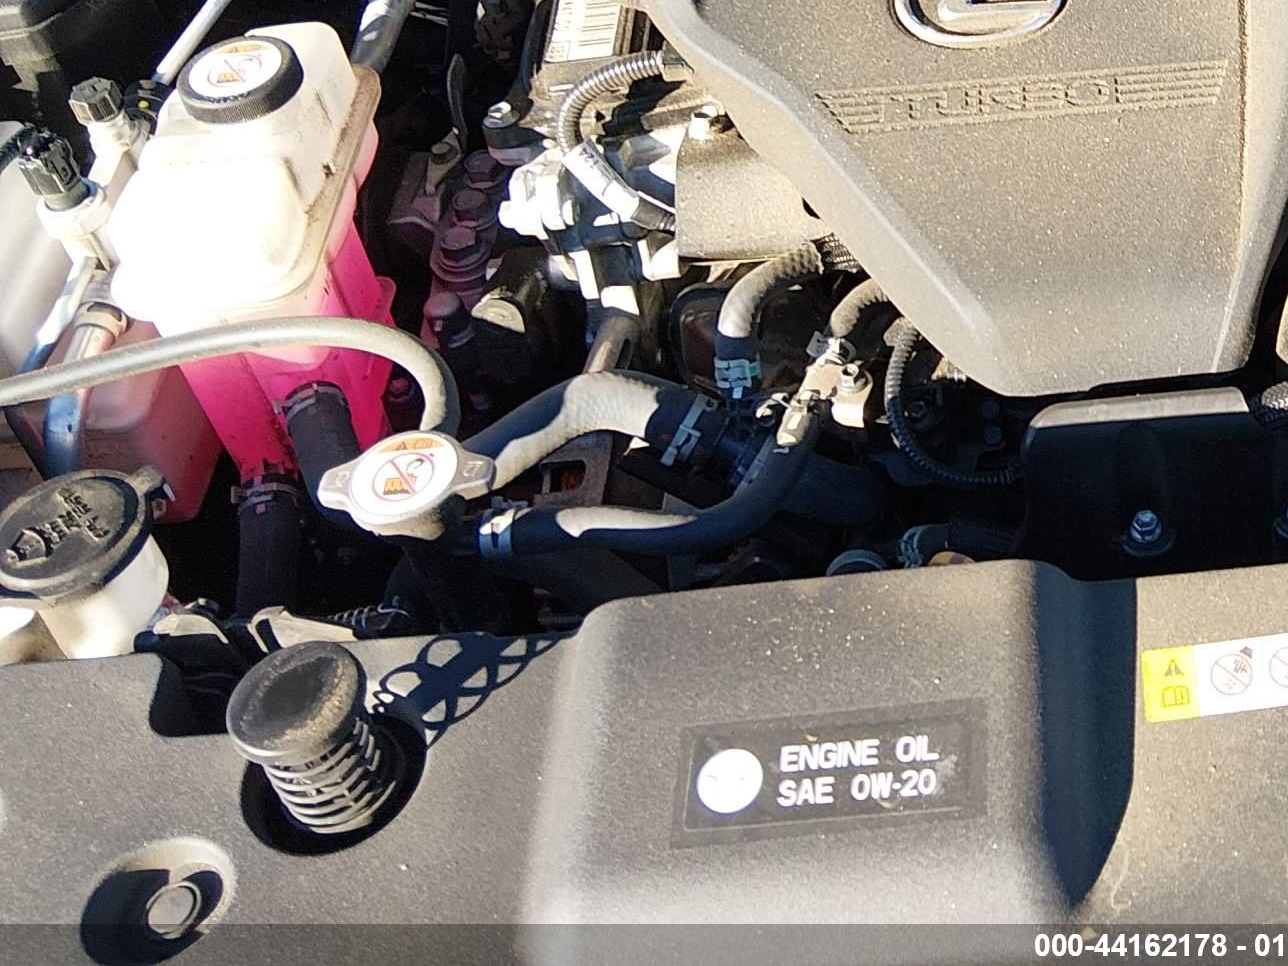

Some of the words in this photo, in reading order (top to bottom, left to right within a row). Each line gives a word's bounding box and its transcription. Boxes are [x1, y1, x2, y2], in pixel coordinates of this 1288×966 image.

[891, 77, 1111, 121] TURBO
[779, 738, 880, 772] ENGINE
[895, 734, 940, 763] OIL
[776, 776, 835, 807] SAE
